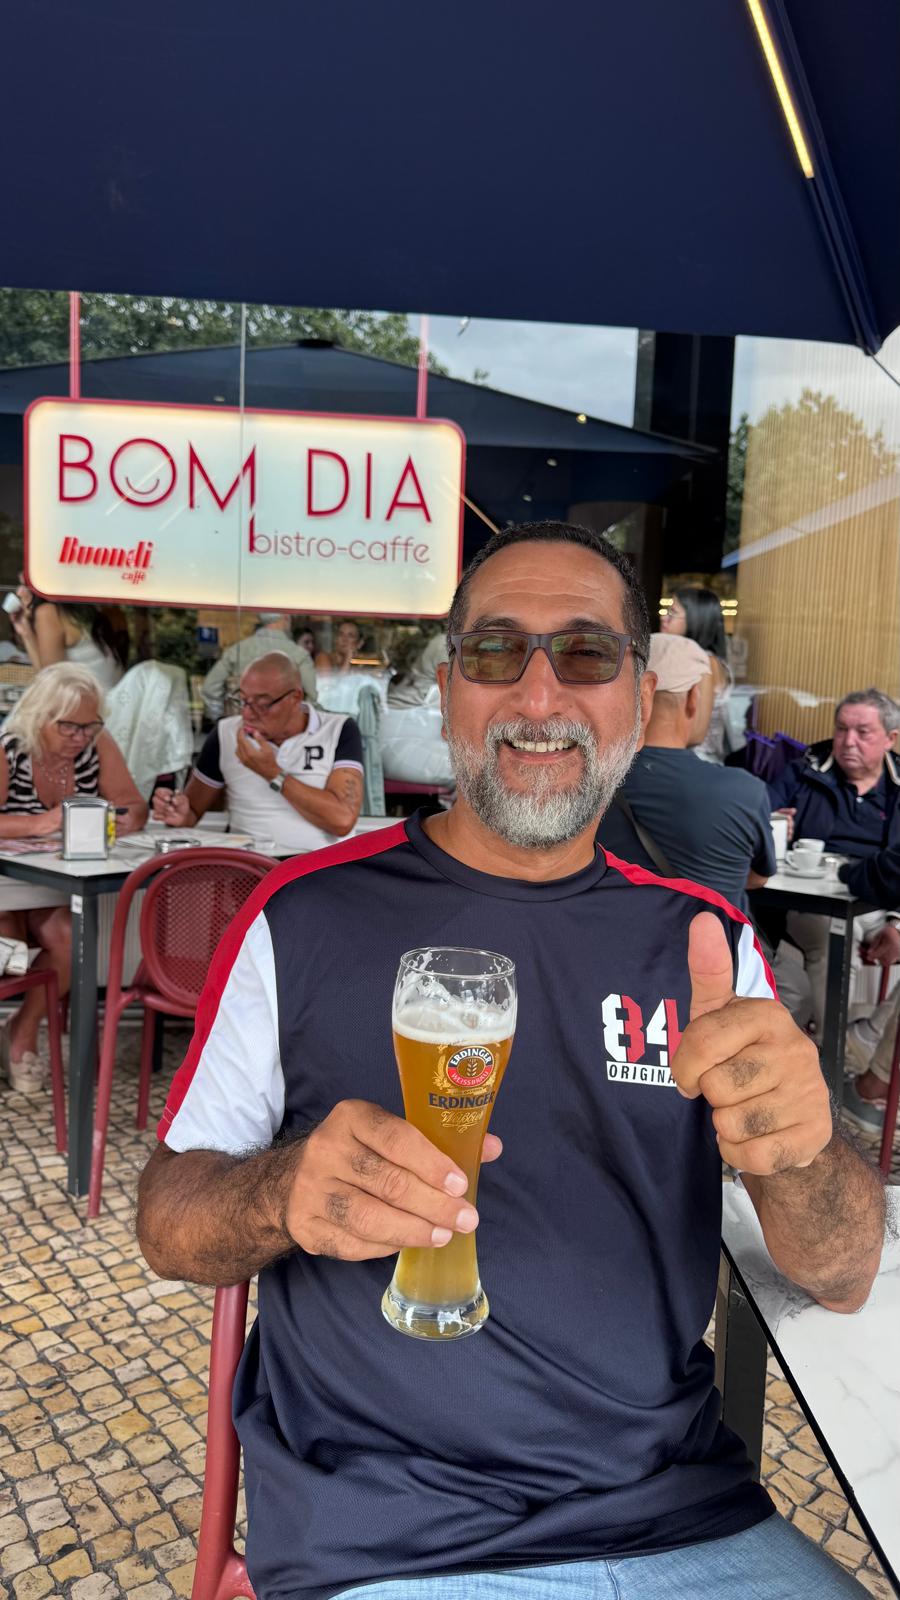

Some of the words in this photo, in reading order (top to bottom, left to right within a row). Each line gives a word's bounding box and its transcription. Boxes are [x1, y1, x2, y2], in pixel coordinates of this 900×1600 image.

[59, 434, 257, 512] BOM
[307, 449, 432, 523] DIA
[59, 537, 154, 568] Buondi
[249, 514, 430, 563] bistro-caffe
[303, 746, 325, 770] P
[601, 994, 684, 1066] 84
[450, 1048, 492, 1066] ERDINGER
[609, 1064, 675, 1084] ORIGINA
